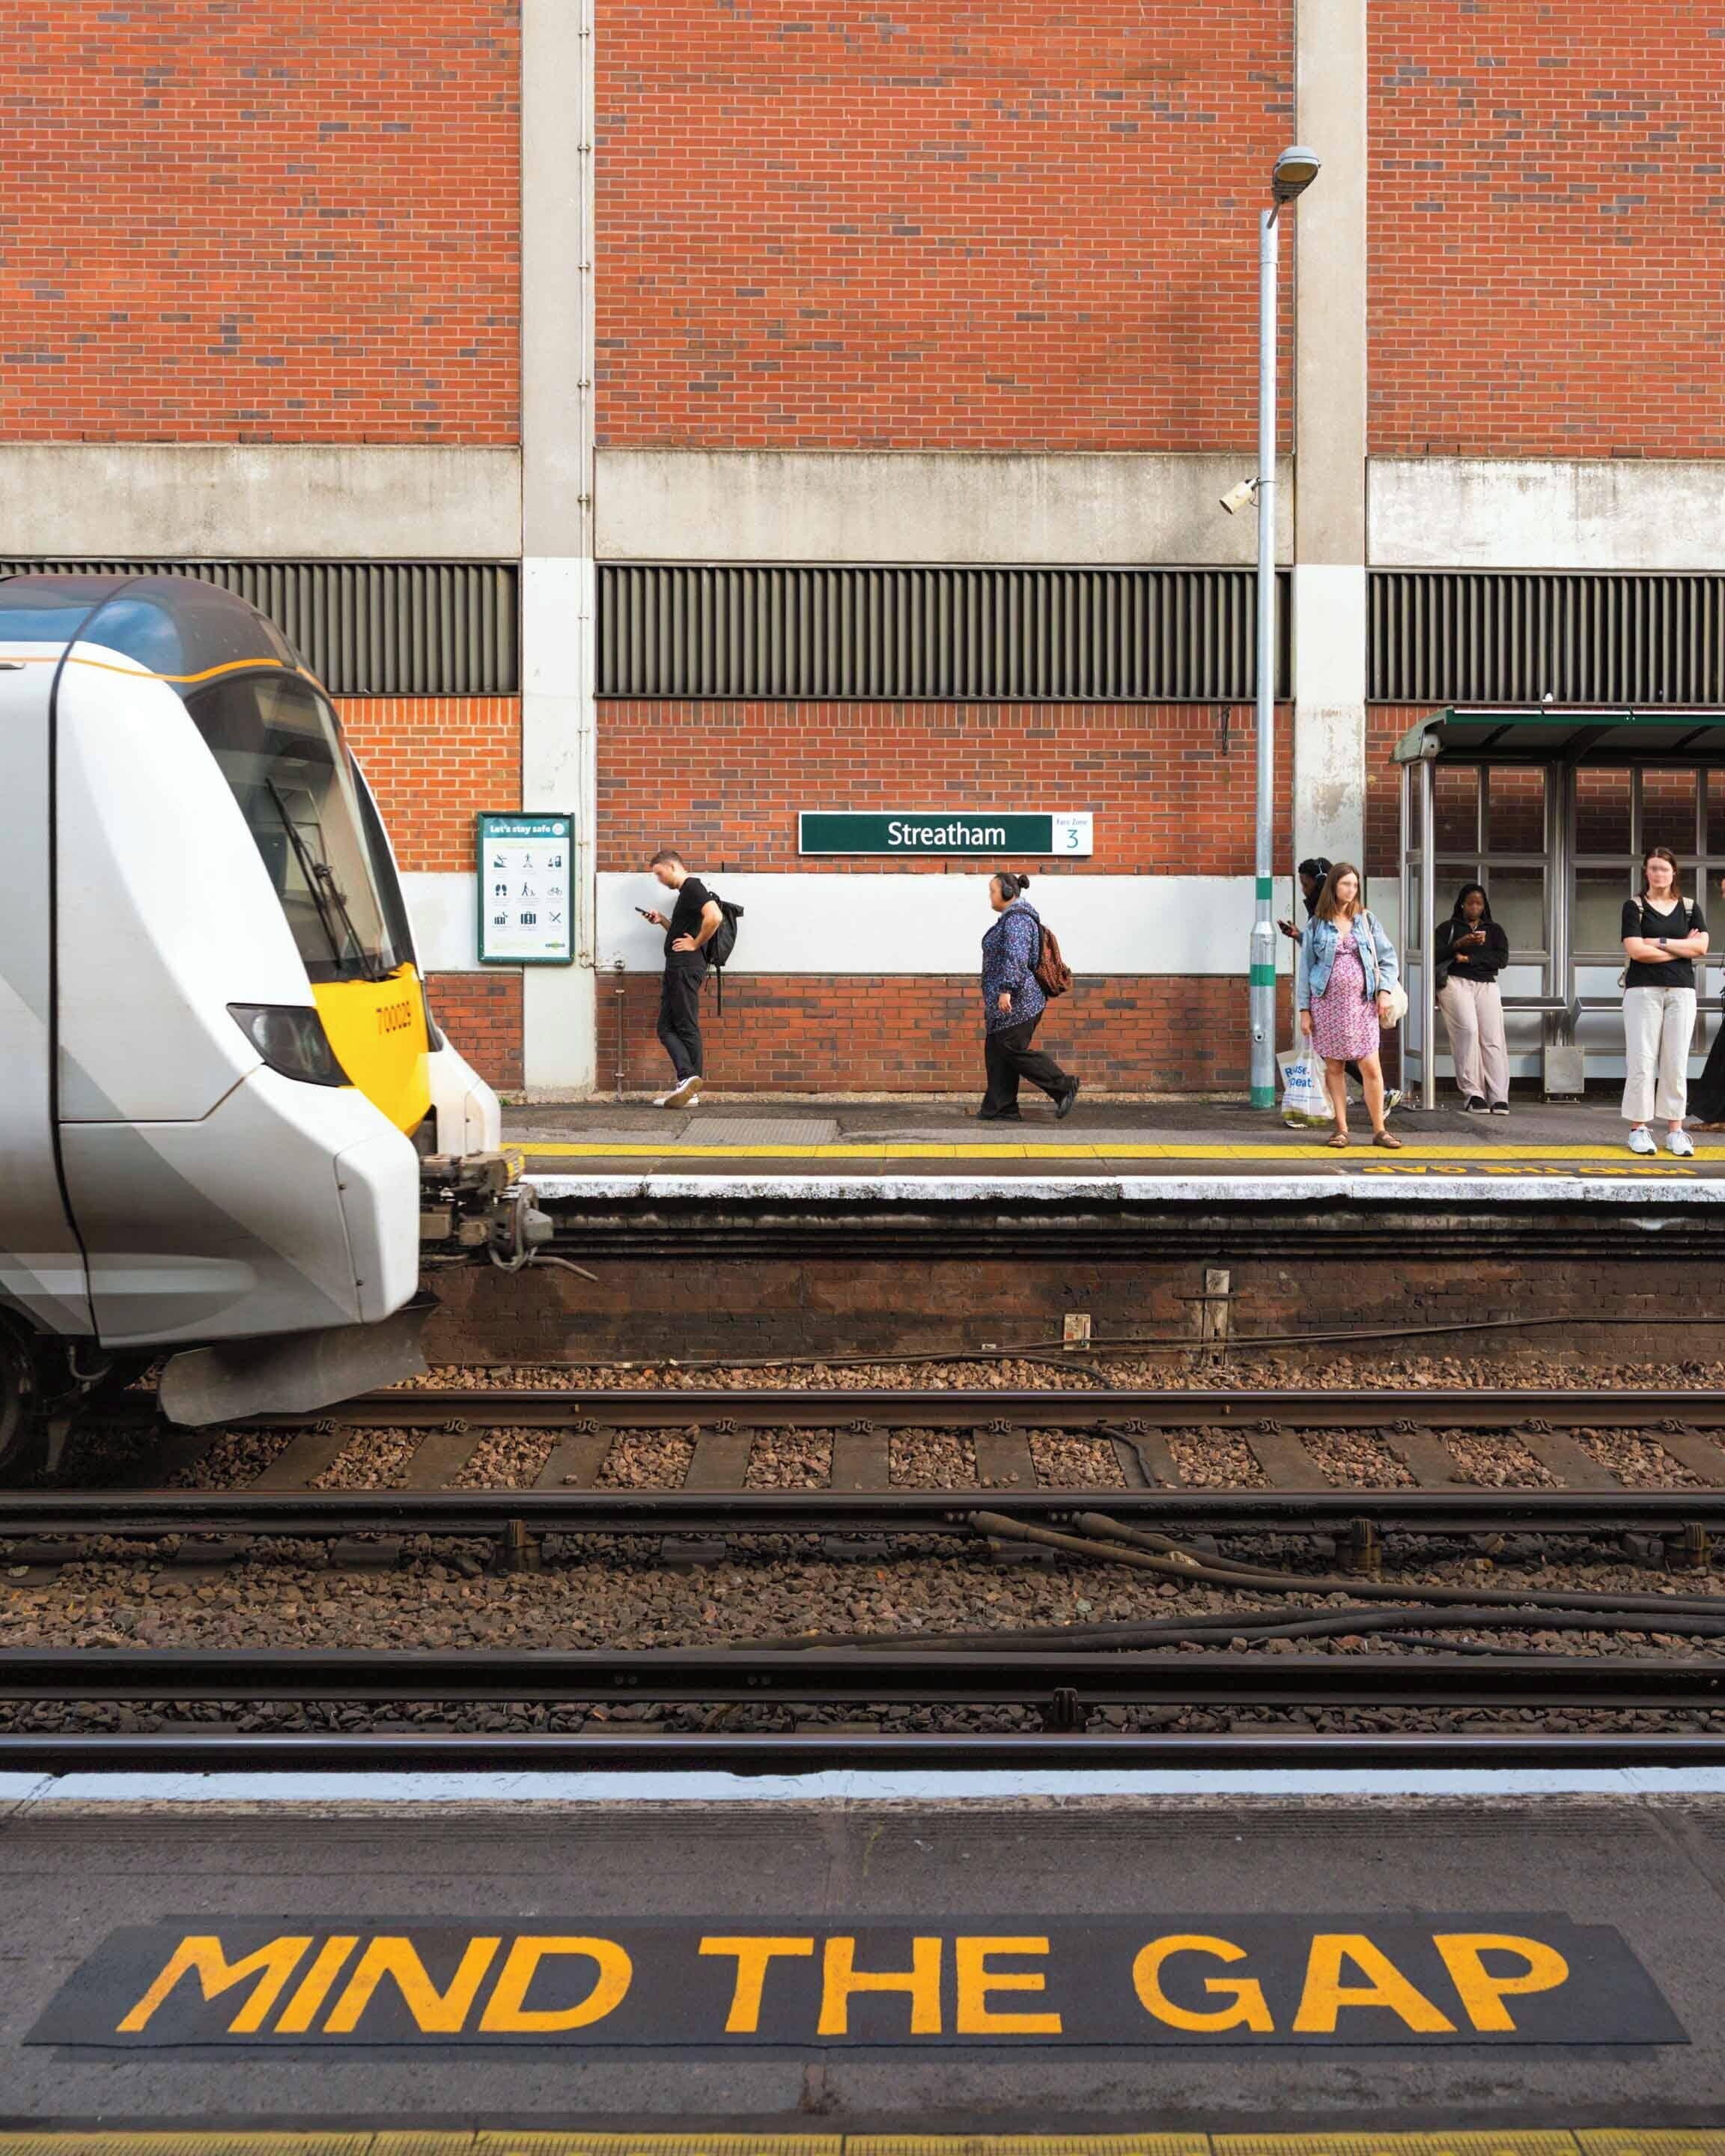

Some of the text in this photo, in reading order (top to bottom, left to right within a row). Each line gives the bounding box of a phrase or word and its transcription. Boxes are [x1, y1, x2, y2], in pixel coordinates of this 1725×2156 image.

[490, 825, 551, 835] Let's stay safe
[888, 822, 1006, 845] Streatham
[1066, 829, 1079, 848] 3
[116, 1934, 1569, 2035] MIND THE GAP
